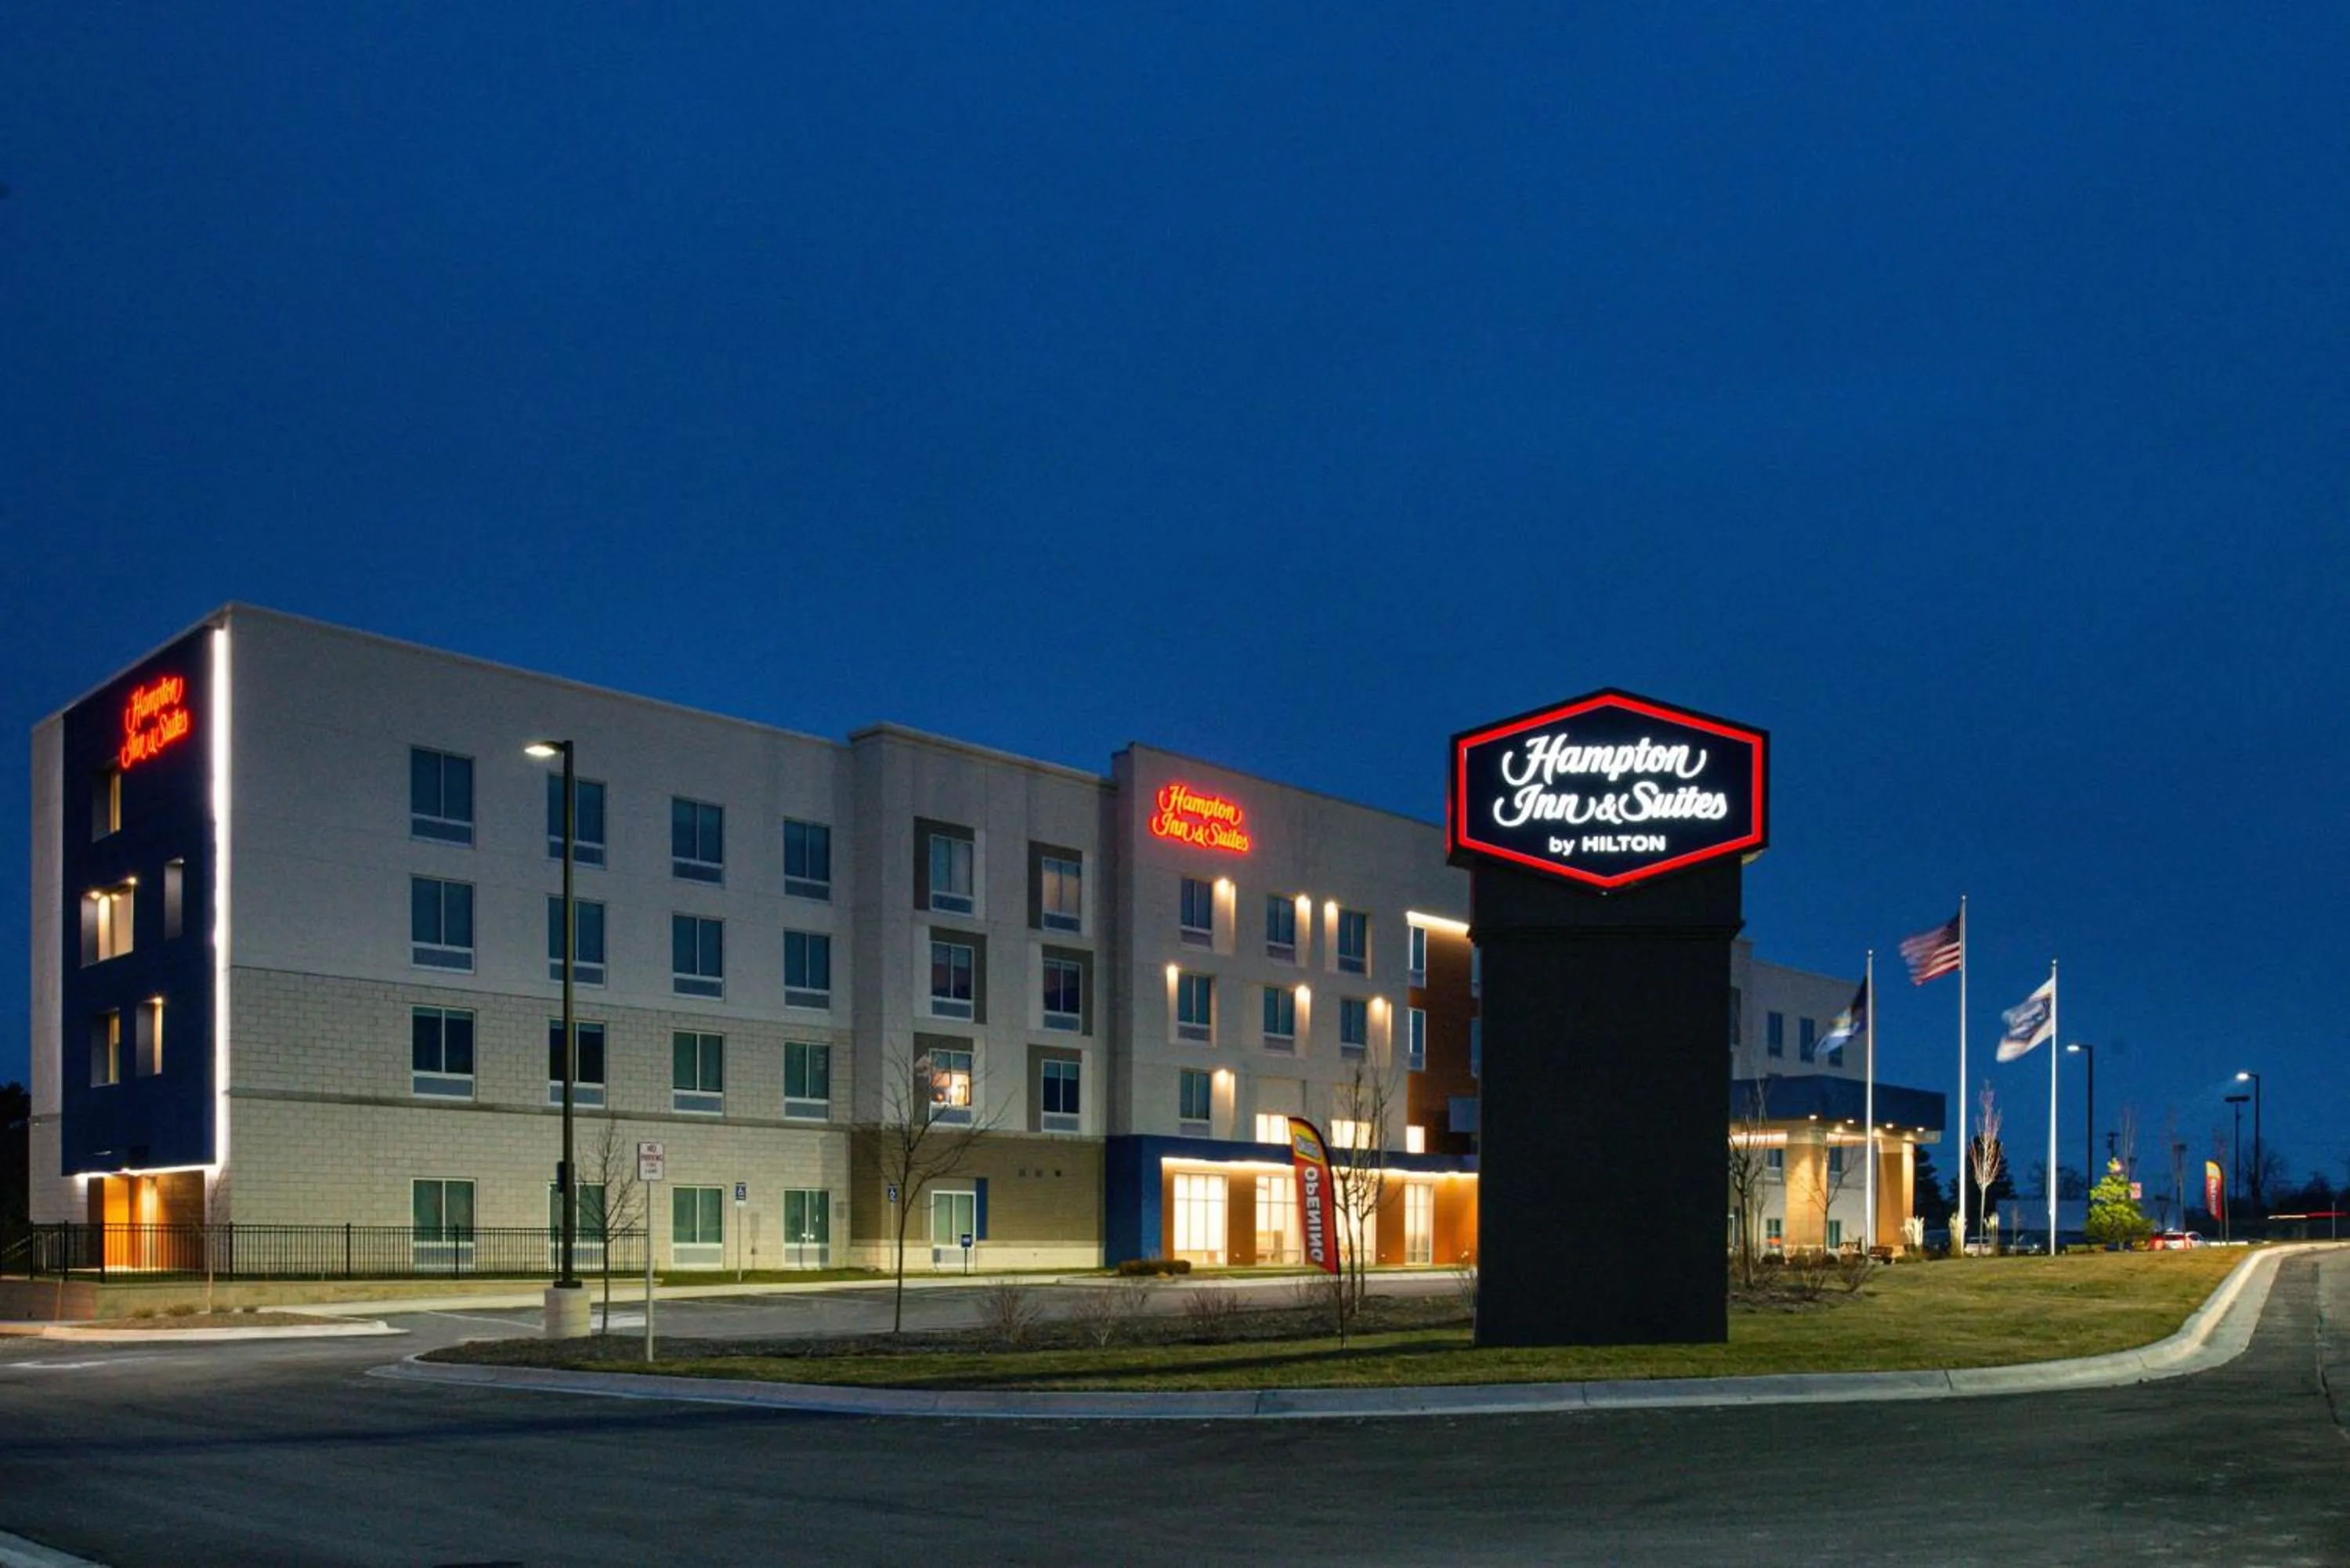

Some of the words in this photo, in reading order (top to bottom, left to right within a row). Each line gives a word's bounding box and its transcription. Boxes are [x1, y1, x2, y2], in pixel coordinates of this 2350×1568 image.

[1502, 733, 1707, 786] Hampton
[1159, 785, 1242, 826] Hampton
[1493, 783, 1598, 827] Inn
[1595, 793, 1623, 825] &
[1618, 781, 1728, 822] Suites
[1152, 812, 1195, 842] Inn
[1195, 825, 1207, 847] &
[1205, 822, 1249, 852] Suites
[1549, 836, 1576, 857] by
[1582, 835, 1667, 853] HILTON
